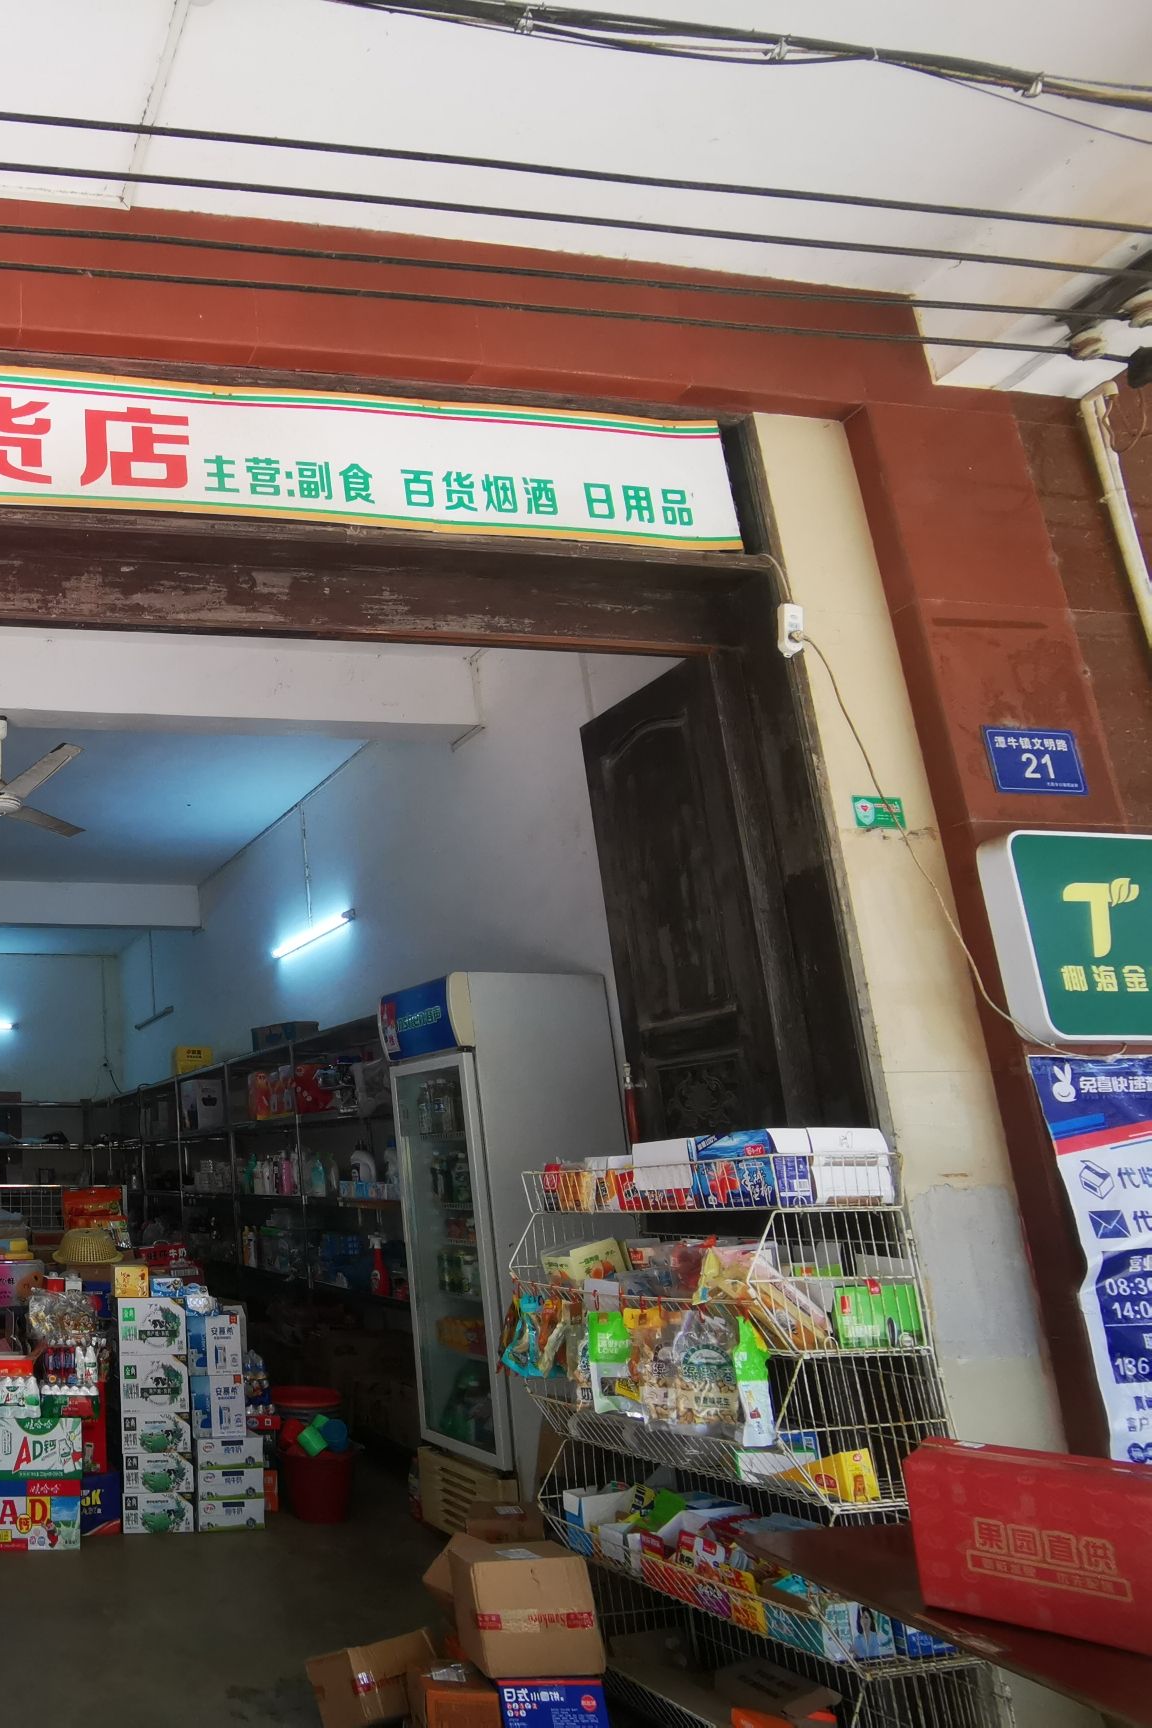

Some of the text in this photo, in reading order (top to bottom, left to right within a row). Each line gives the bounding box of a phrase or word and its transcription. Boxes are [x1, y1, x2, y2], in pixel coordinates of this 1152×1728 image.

[204, 455, 694, 526] 主营:副食 百货烟酒 日用品
[994, 735, 1068, 752] 潭牛镇文明路
[1021, 752, 1055, 779] 21
[210, 1326, 234, 1336] 安慕希
